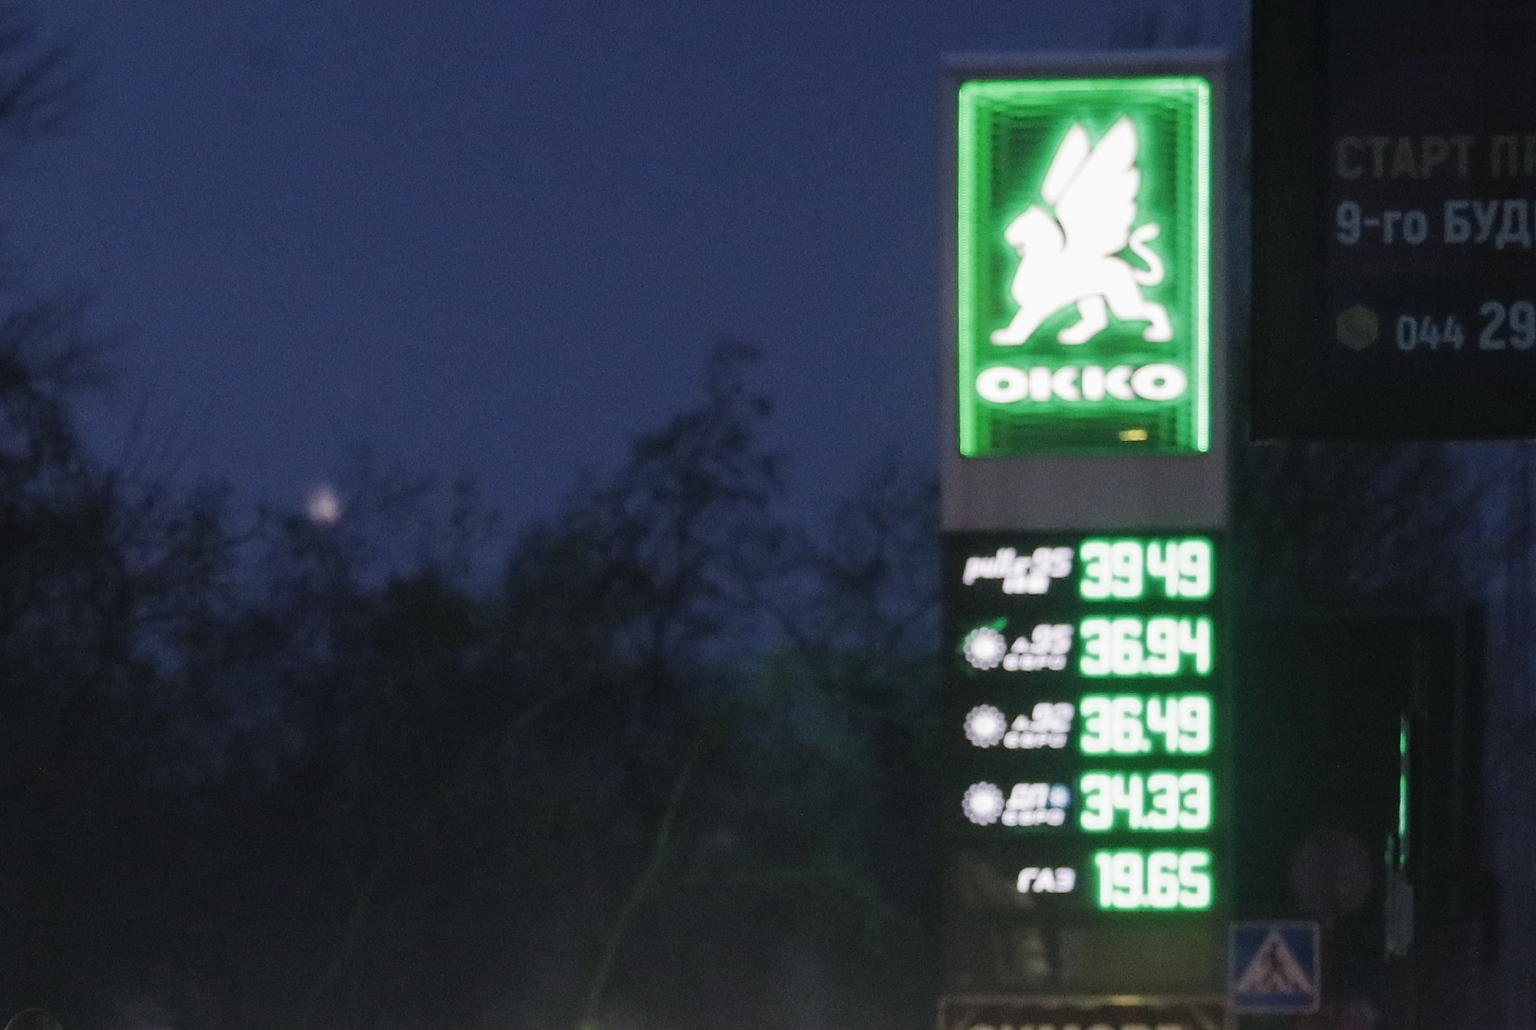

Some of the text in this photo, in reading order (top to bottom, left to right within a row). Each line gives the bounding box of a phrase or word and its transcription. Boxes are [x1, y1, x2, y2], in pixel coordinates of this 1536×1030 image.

[1334, 134, 1476, 180] СТАРТ
[1335, 199, 1536, 251] 9-го БУД
[1395, 313, 1464, 352] 044
[975, 362, 1187, 403] OKKO
[1079, 616, 1212, 676] 36.94
[1079, 694, 1212, 754] 36.49
[1079, 772, 1212, 832] 34.33
[1094, 850, 1212, 910] 19.65
